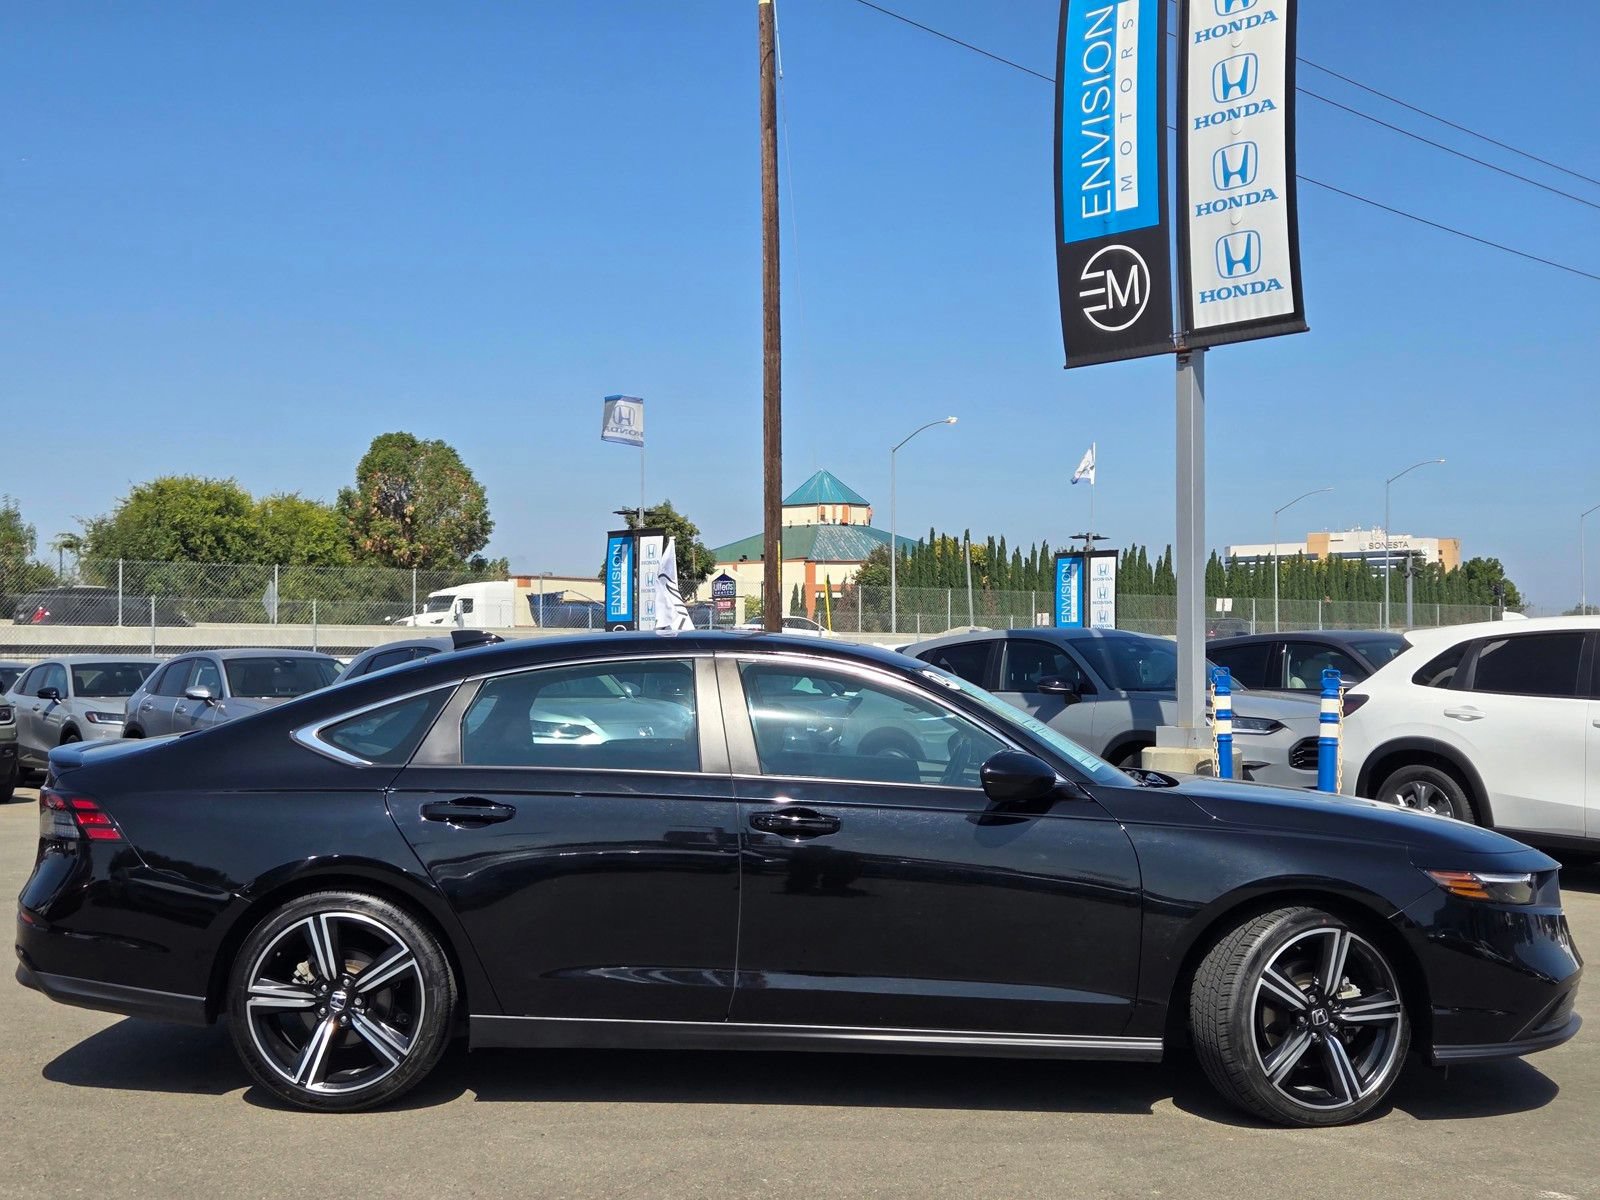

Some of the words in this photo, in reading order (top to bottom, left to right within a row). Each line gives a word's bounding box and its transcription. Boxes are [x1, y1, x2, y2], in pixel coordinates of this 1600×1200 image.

[1194, 9, 1279, 44] HONDA
[1081, 4, 1114, 219] ENVISION
[1120, 18, 1134, 192] MOTORS
[1194, 98, 1277, 130] HONDA
[1195, 187, 1279, 217] HONDA
[1199, 277, 1285, 304] HONDA
[1369, 541, 1409, 550] SONESTA
[611, 544, 621, 615] ENVISION
[1061, 564, 1070, 622] ENVISION
